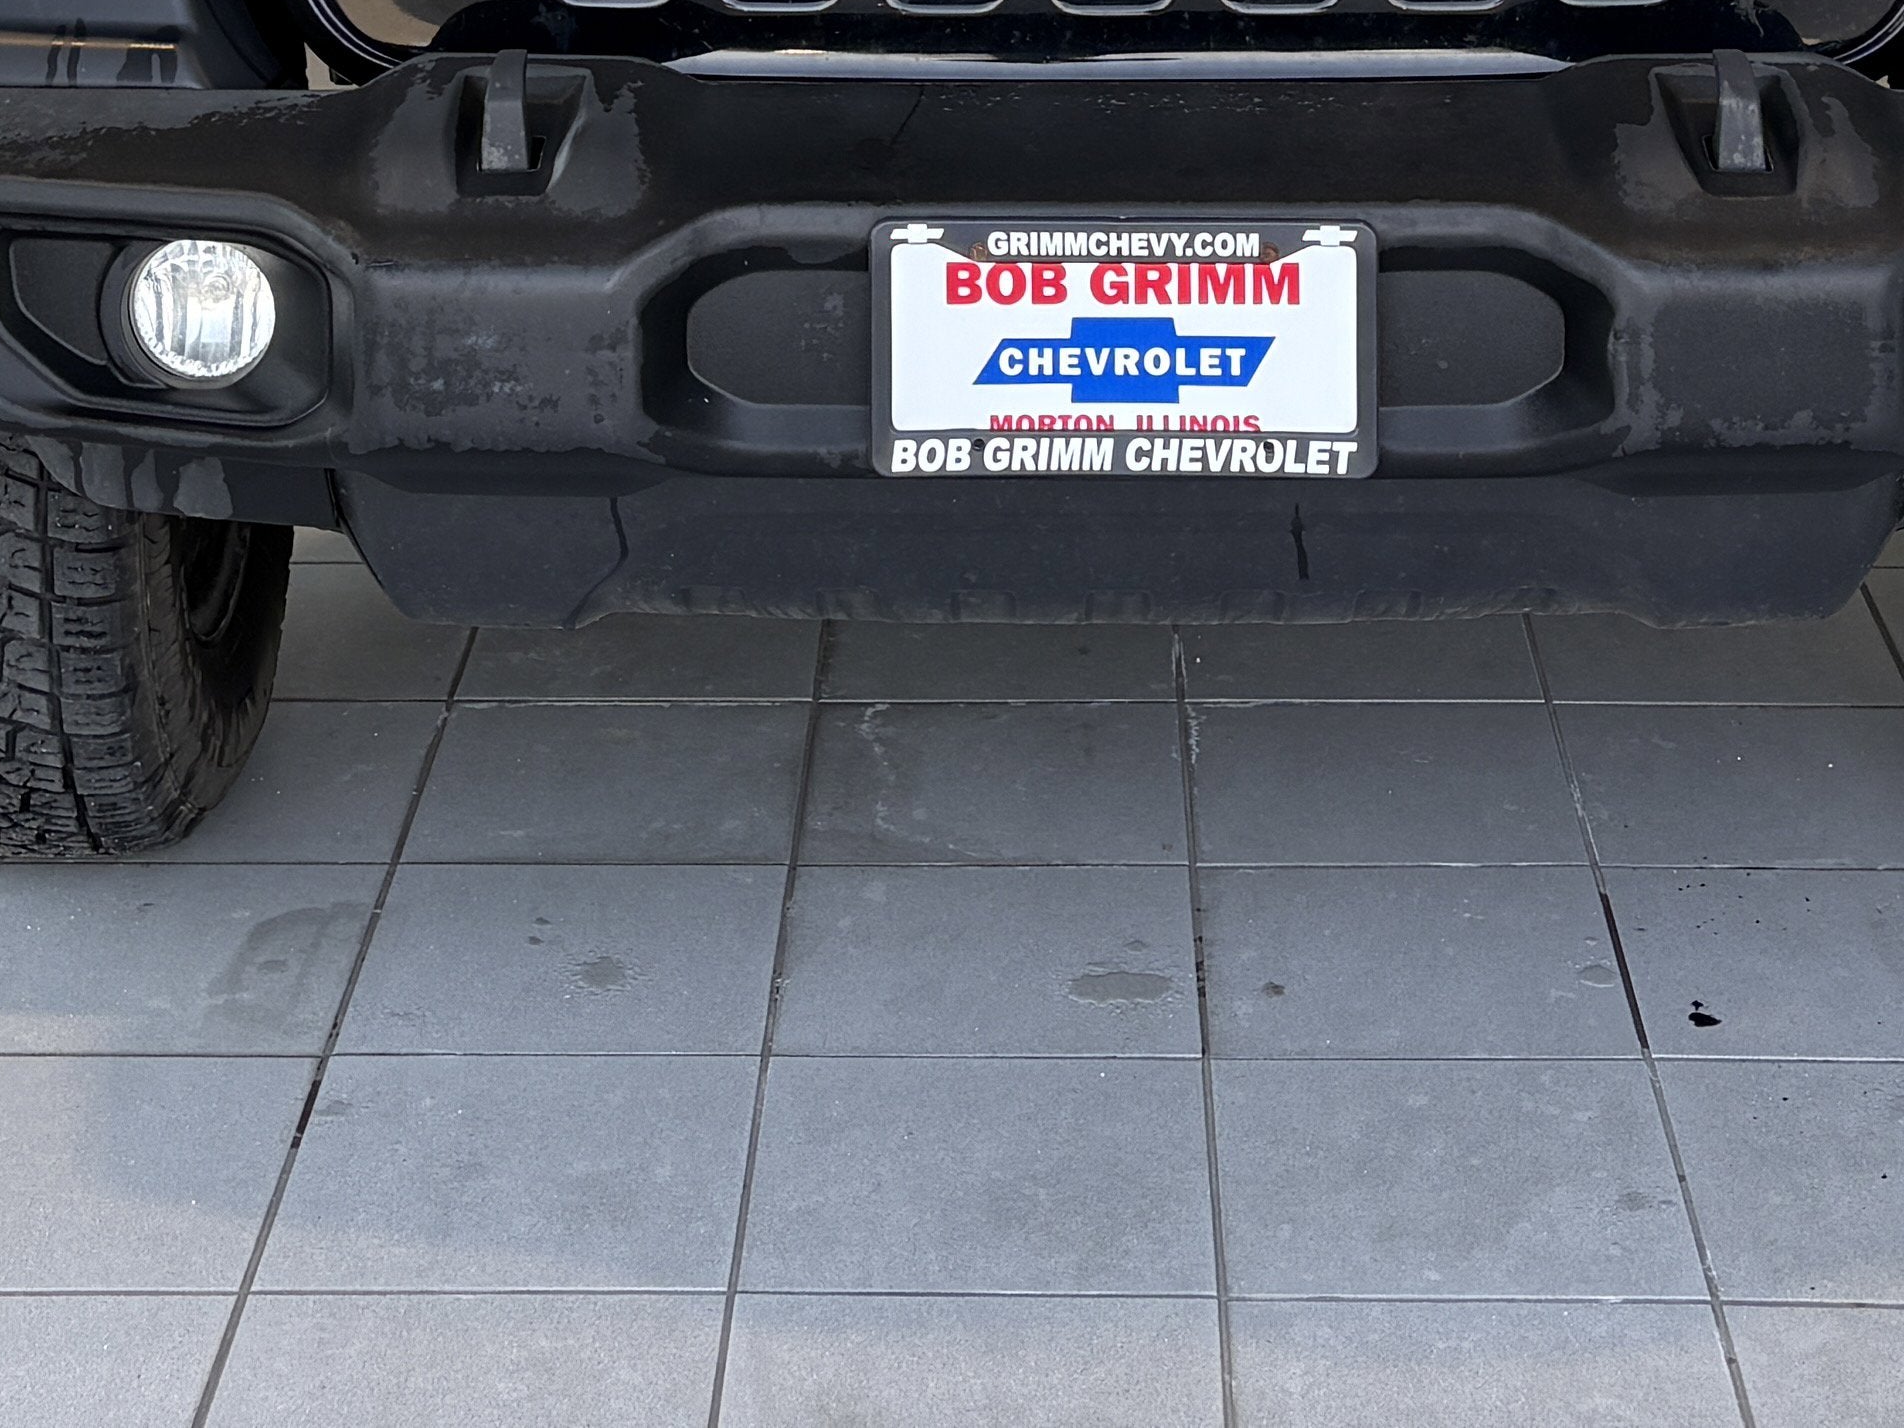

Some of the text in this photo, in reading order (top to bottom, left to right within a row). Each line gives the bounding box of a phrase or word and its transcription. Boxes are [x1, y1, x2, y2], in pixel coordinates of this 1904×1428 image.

[987, 231, 1260, 258] GRIMMCHEVY.COM
[945, 262, 1301, 306] BOB GRIMM
[998, 346, 1248, 377] CHEVROLET
[989, 414, 1115, 432] MORTON
[891, 438, 1358, 475] BOB GRIMM CHEVROLET
